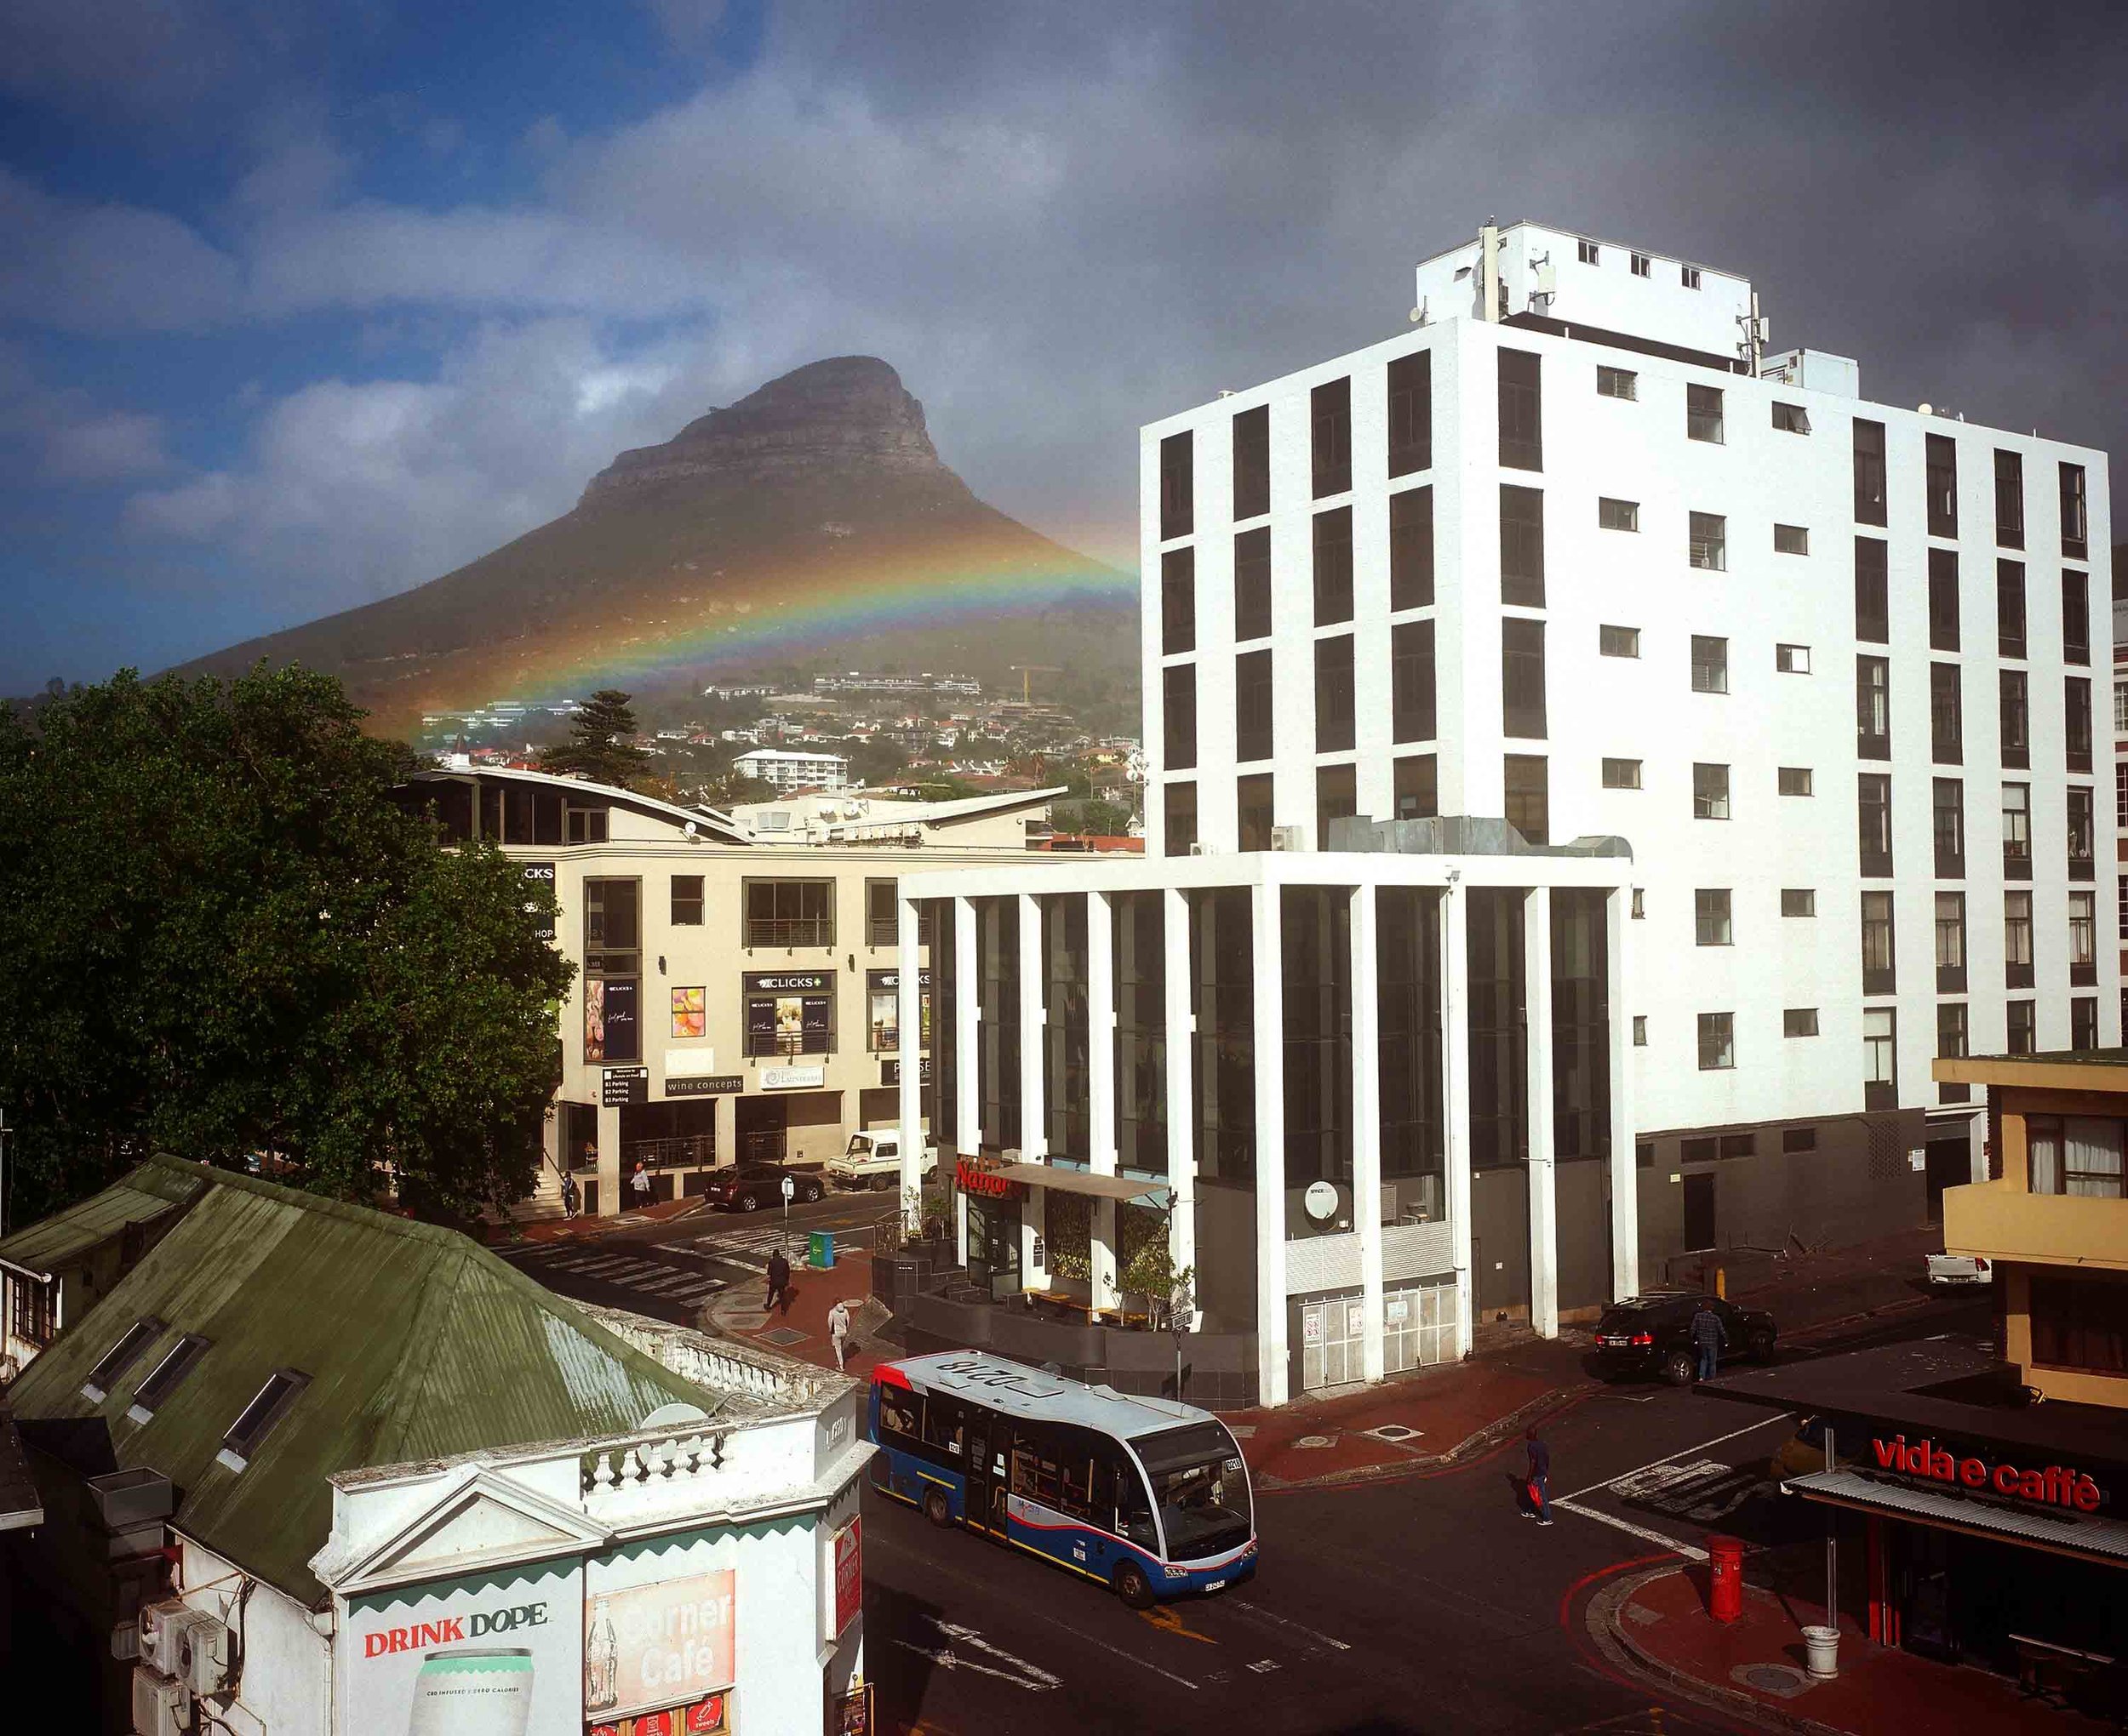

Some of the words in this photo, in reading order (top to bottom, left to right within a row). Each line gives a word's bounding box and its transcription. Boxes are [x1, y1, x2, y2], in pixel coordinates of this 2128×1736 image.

[770, 977, 814, 988] CLICKS
[667, 1081, 693, 1091] wine
[697, 1079, 742, 1091] concepts
[1873, 1434, 1954, 1482] vida
[1959, 1458, 1987, 1488] e
[1992, 1465, 2101, 1511] caffè
[364, 1616, 465, 1659] DRINK
[469, 1601, 549, 1638] DOPE
[641, 1634, 716, 1688] Café
